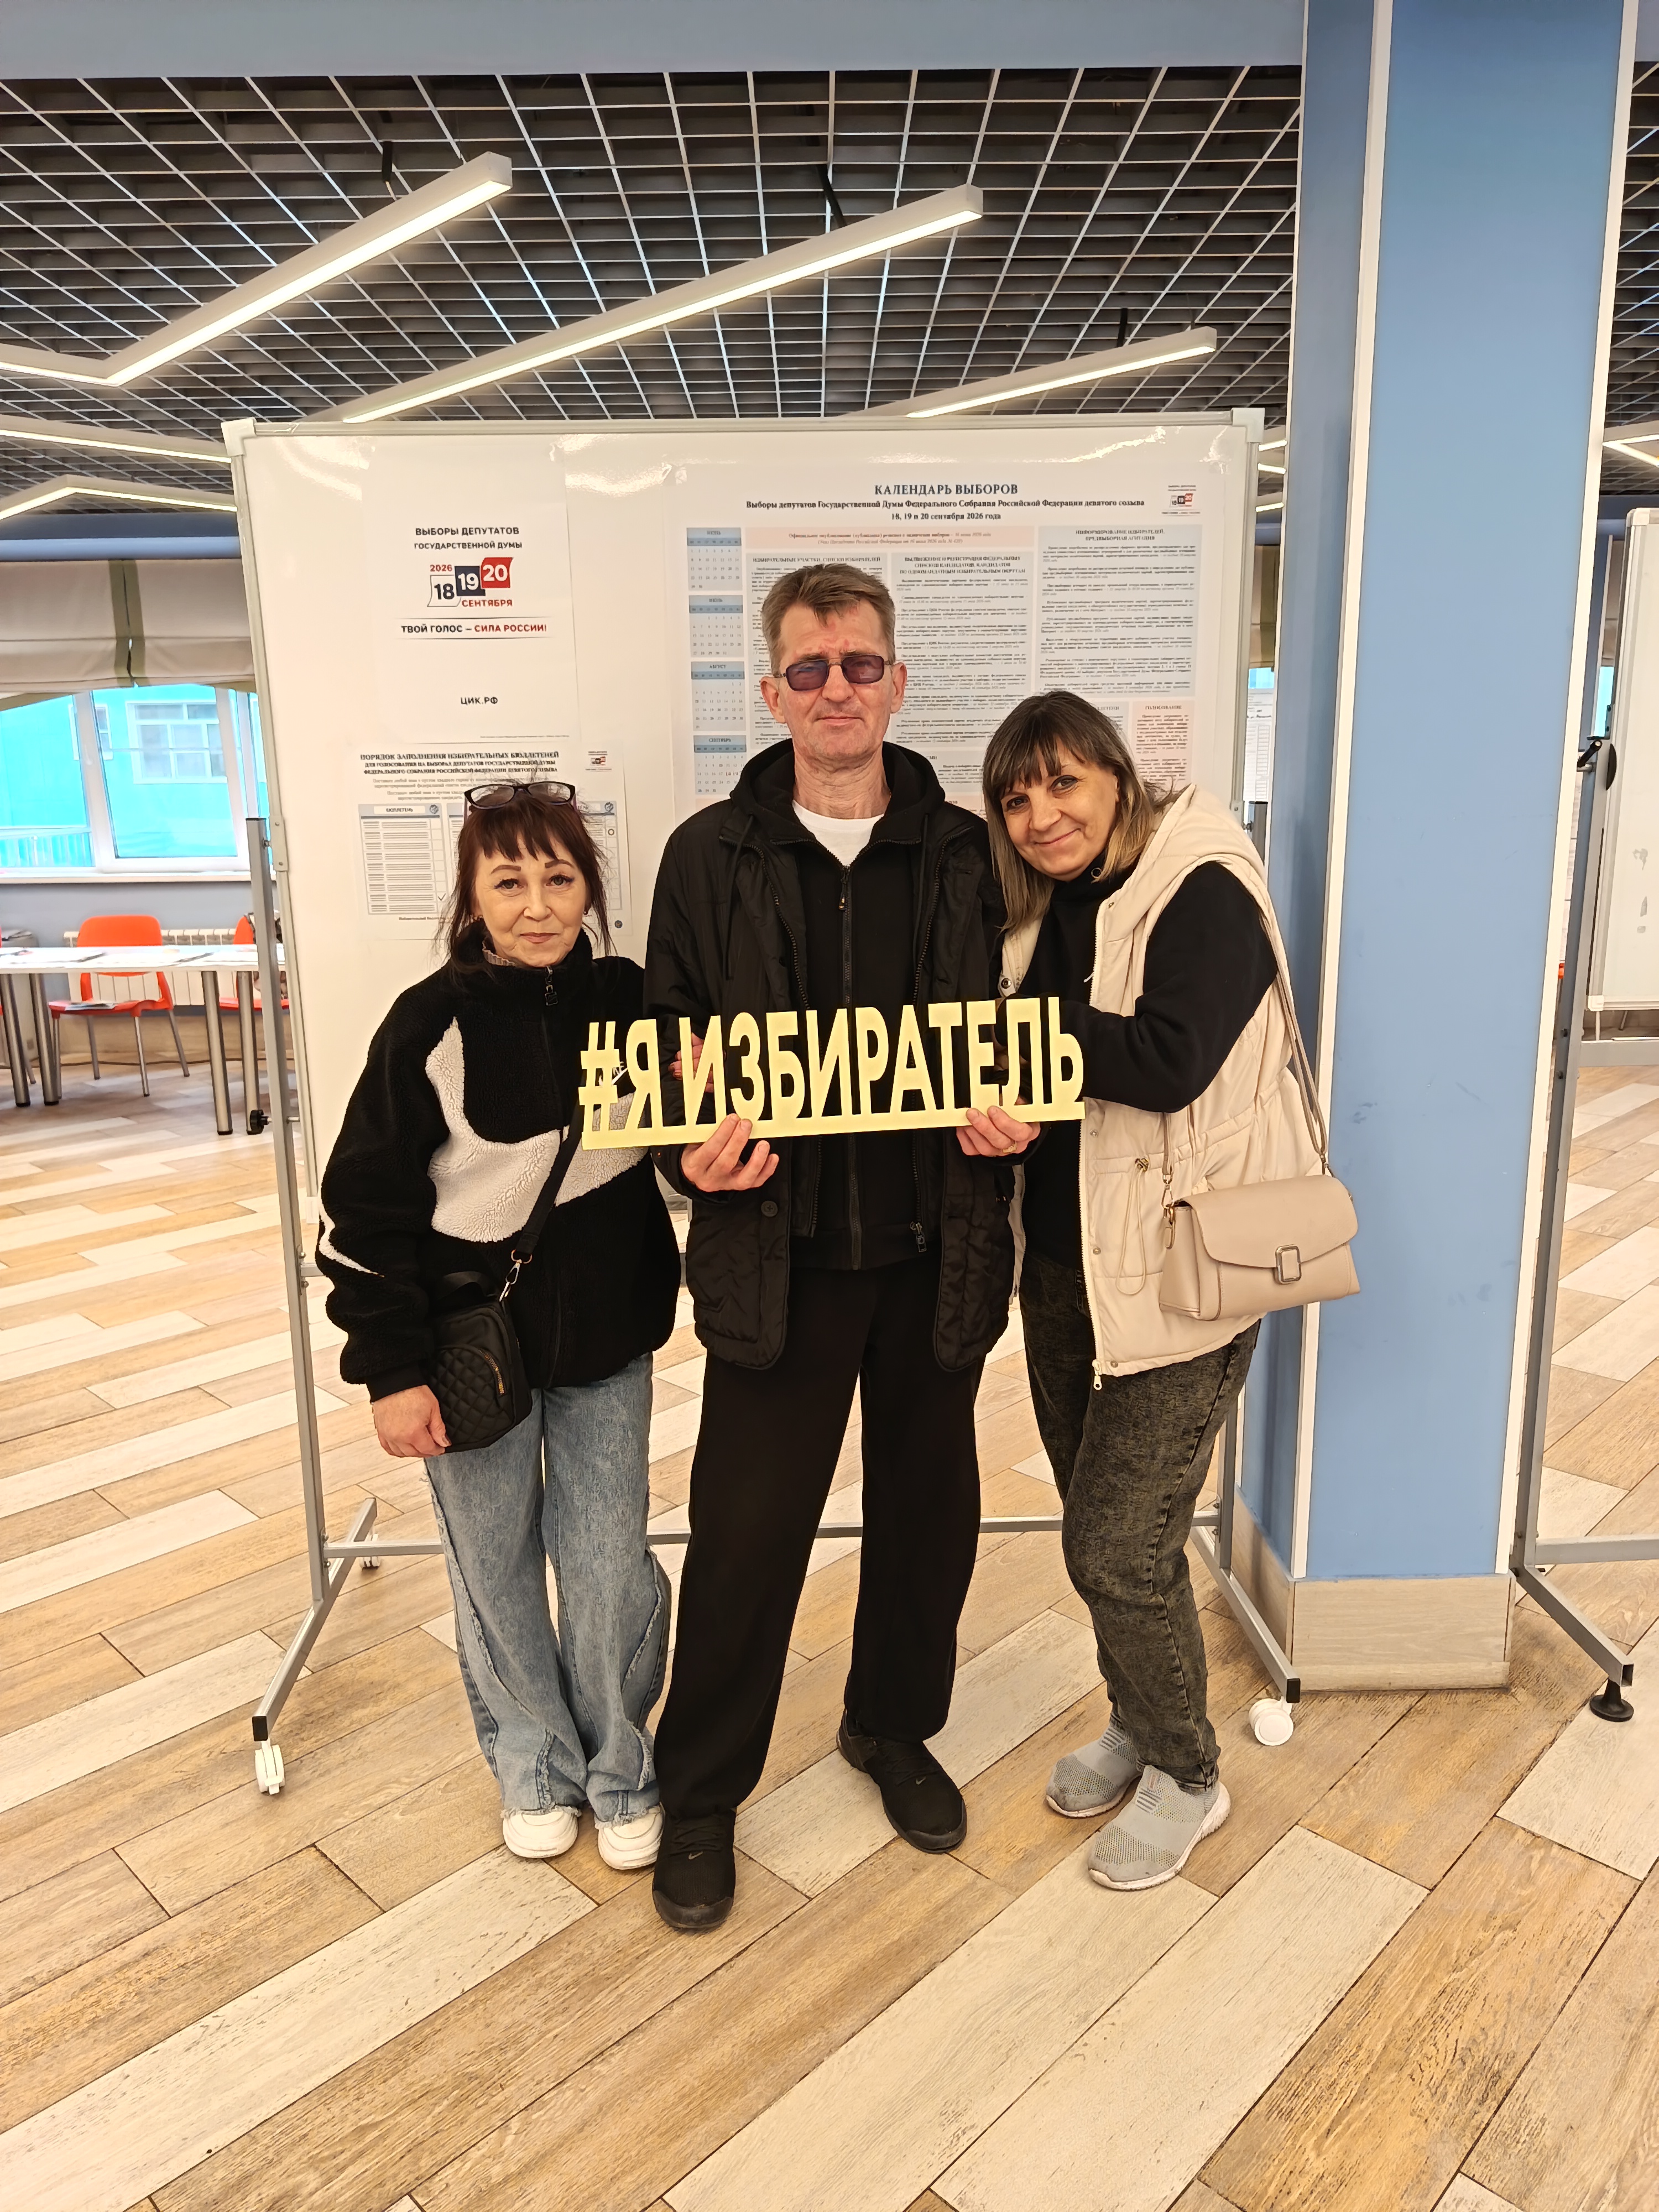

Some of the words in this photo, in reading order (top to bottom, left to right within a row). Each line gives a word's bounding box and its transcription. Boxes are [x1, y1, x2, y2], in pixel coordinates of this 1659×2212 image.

[875, 484, 952, 496] КАЛЕНДАРЬ
[956, 484, 1018, 494] ВЫБОРОВ
[746, 501, 778, 510] Выборы
[818, 500, 880, 510] Государственной
[882, 500, 904, 509] Думы
[905, 500, 957, 509] Федерального
[958, 499, 995, 509] Собрания
[1042, 499, 1083, 508] Федерации
[931, 512, 964, 521] сентября
[461, 527, 519, 535] ДЕПУТАТОВ
[483, 564, 508, 581] 20
[458, 573, 479, 590] 19
[434, 583, 455, 600] 18
[401, 624, 427, 633] ТВОЙ
[578, 1019, 662, 1131] #Я
[679, 997, 1084, 1126] ИЗБИРАТЕЛЬ
